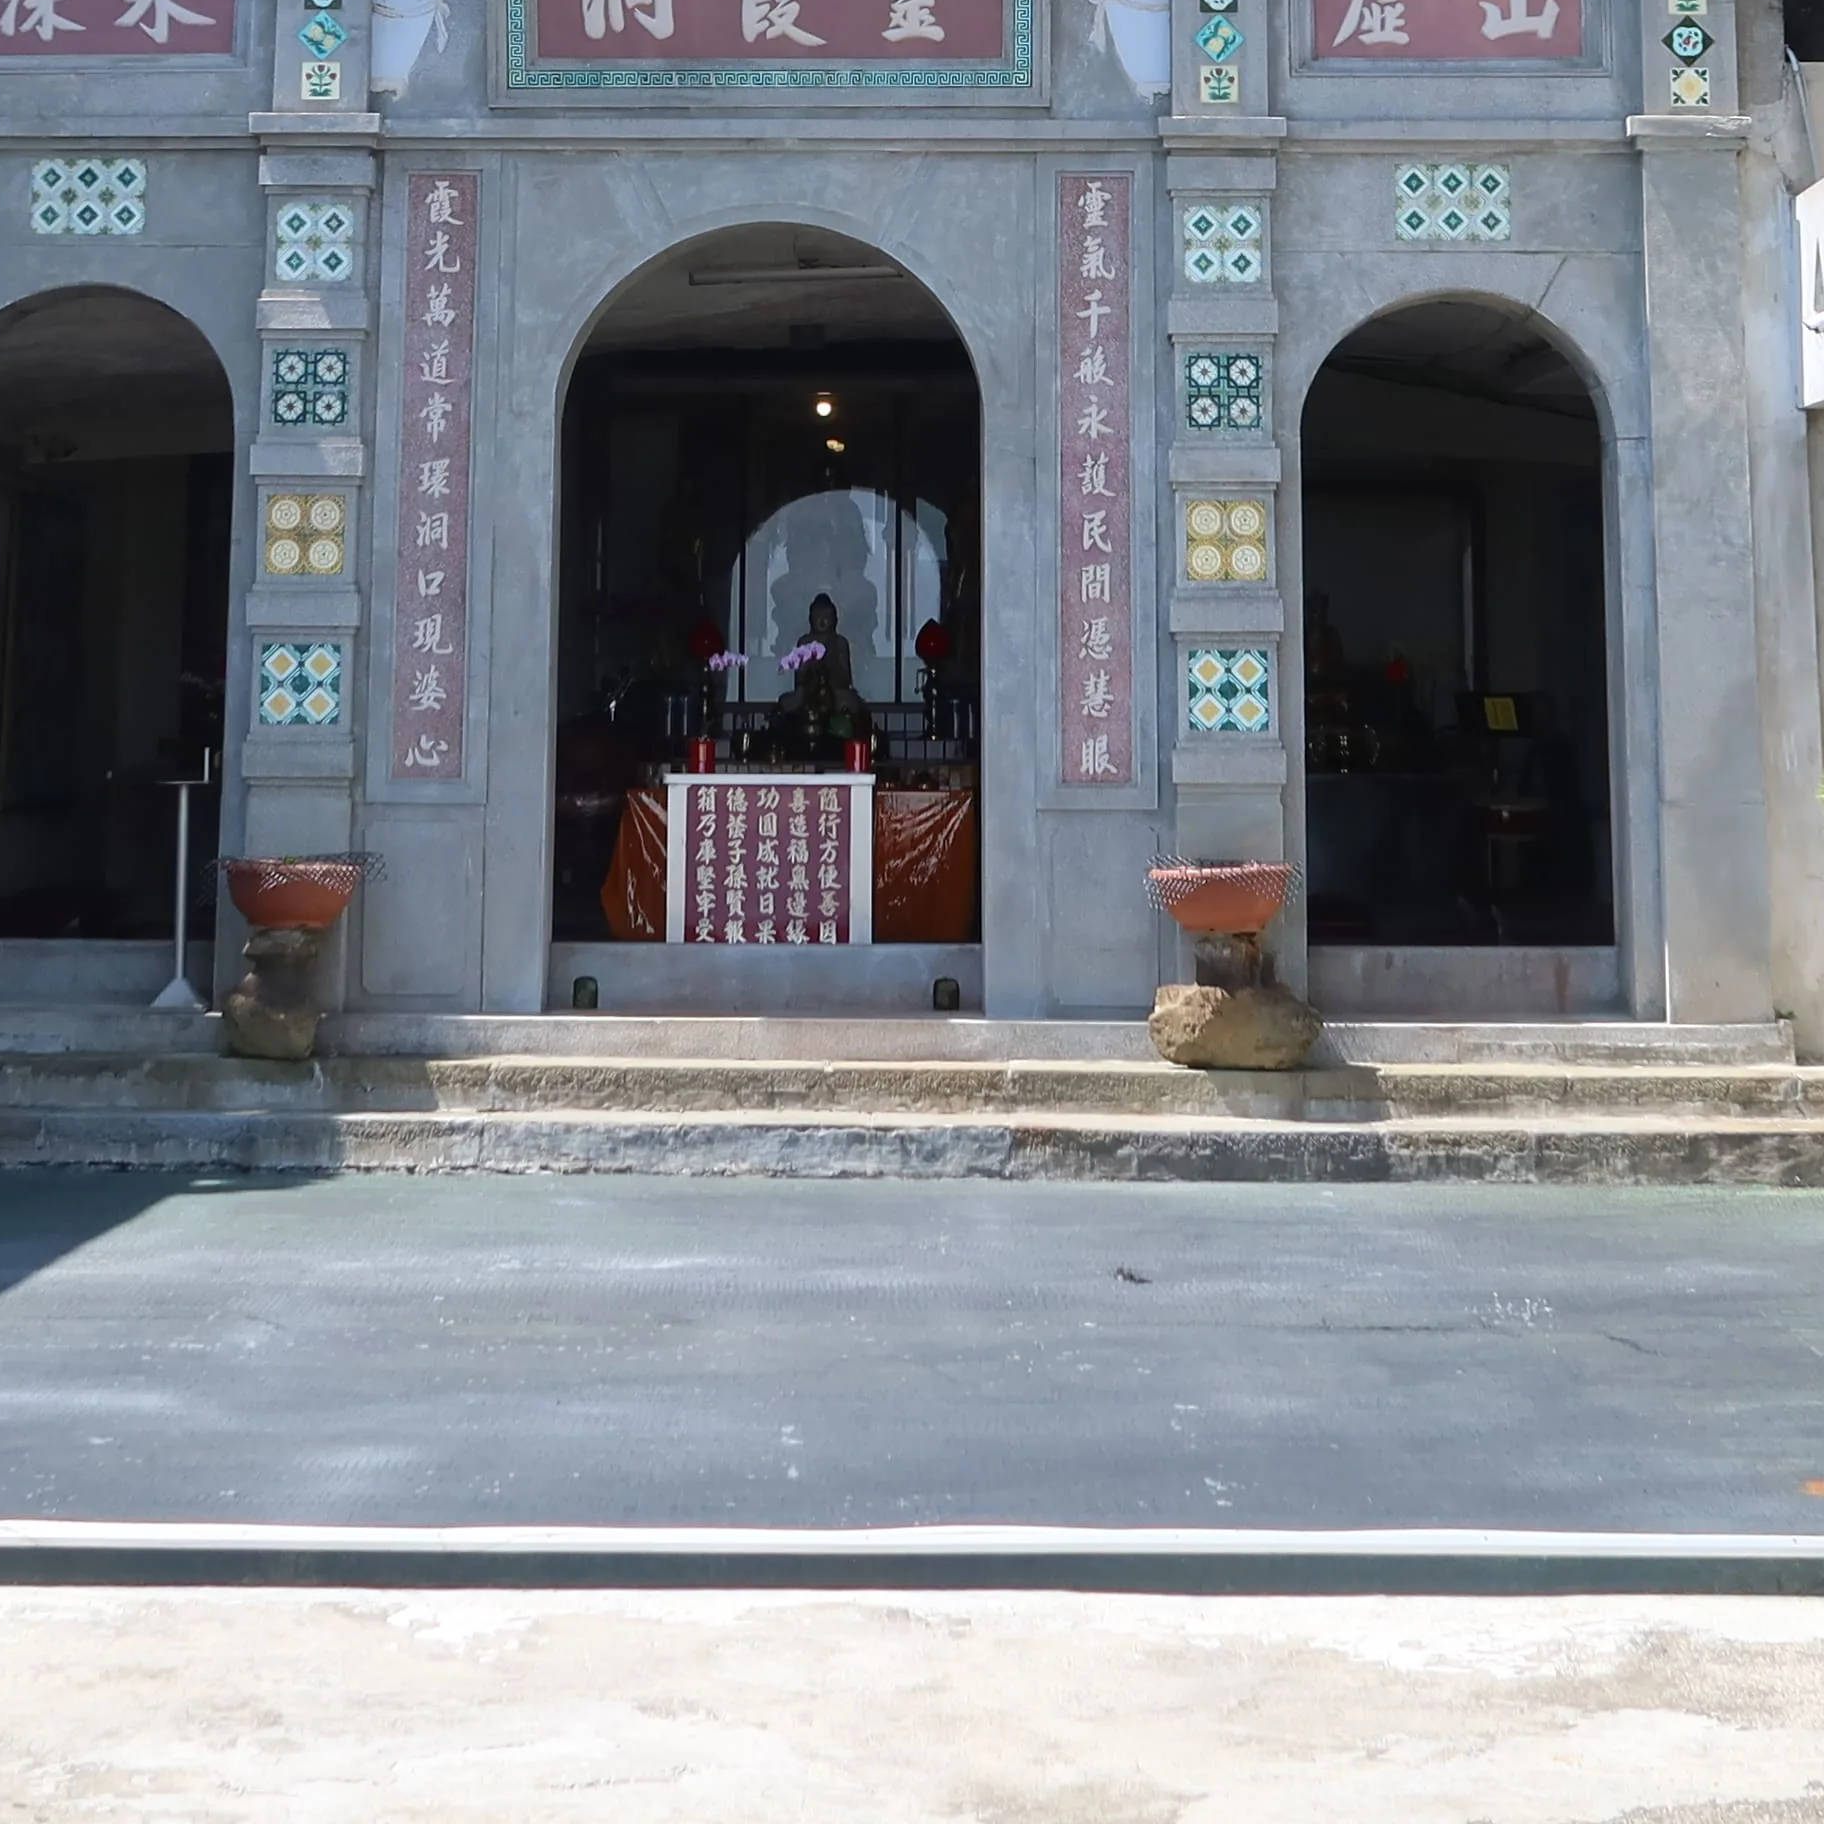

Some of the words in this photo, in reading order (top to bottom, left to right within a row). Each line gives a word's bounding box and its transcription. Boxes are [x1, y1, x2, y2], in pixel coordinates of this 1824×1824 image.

[404, 180, 465, 768] 霞光萬道常環洞口現婆心
[1073, 181, 1118, 776] 靈氣千般永護民間憑慧眼
